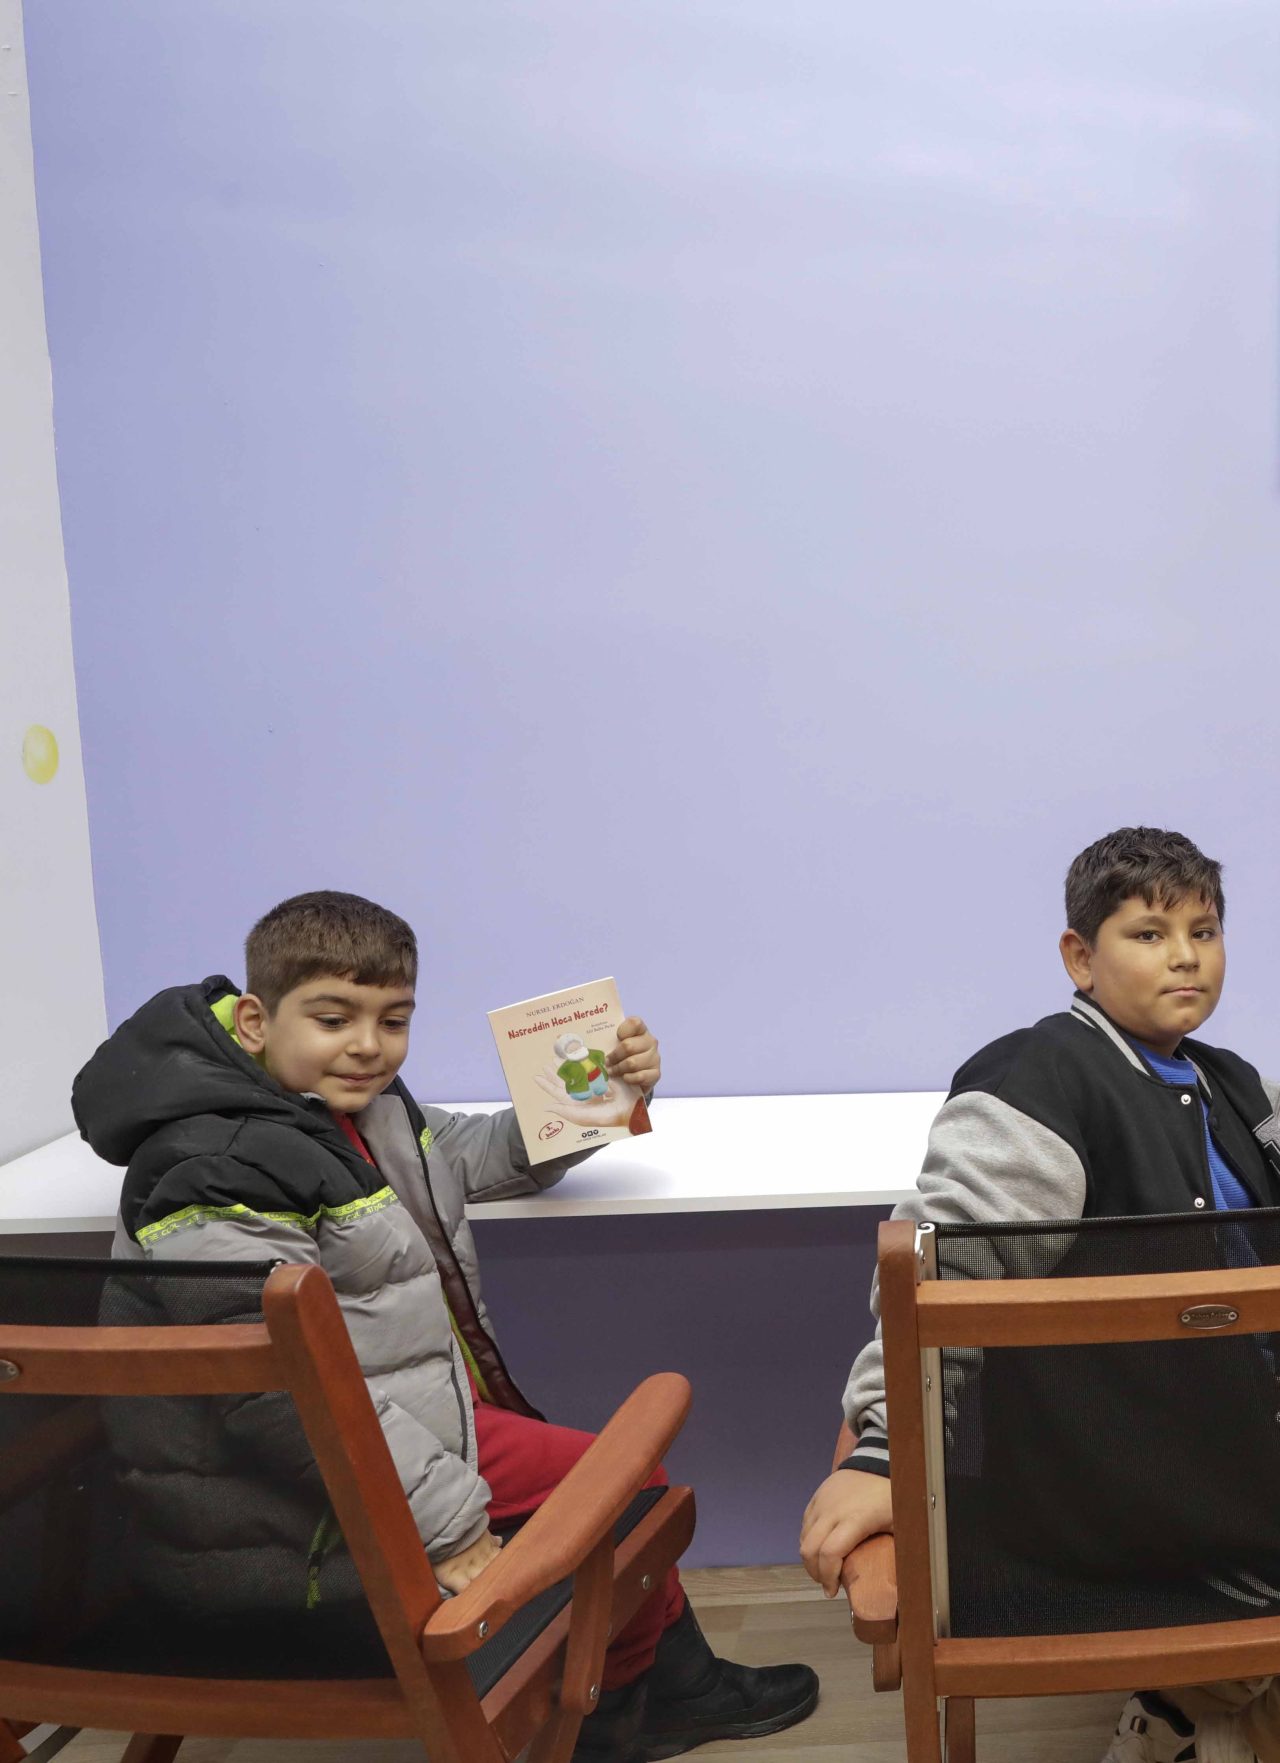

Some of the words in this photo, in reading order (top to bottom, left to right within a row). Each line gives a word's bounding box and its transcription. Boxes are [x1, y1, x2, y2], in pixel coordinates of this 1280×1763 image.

[508, 1021, 550, 1040] Nasreddin
[551, 1015, 573, 1027] Hoca
[573, 1003, 609, 1021] Nerede?
[526, 1005, 551, 1017] NURSEL
